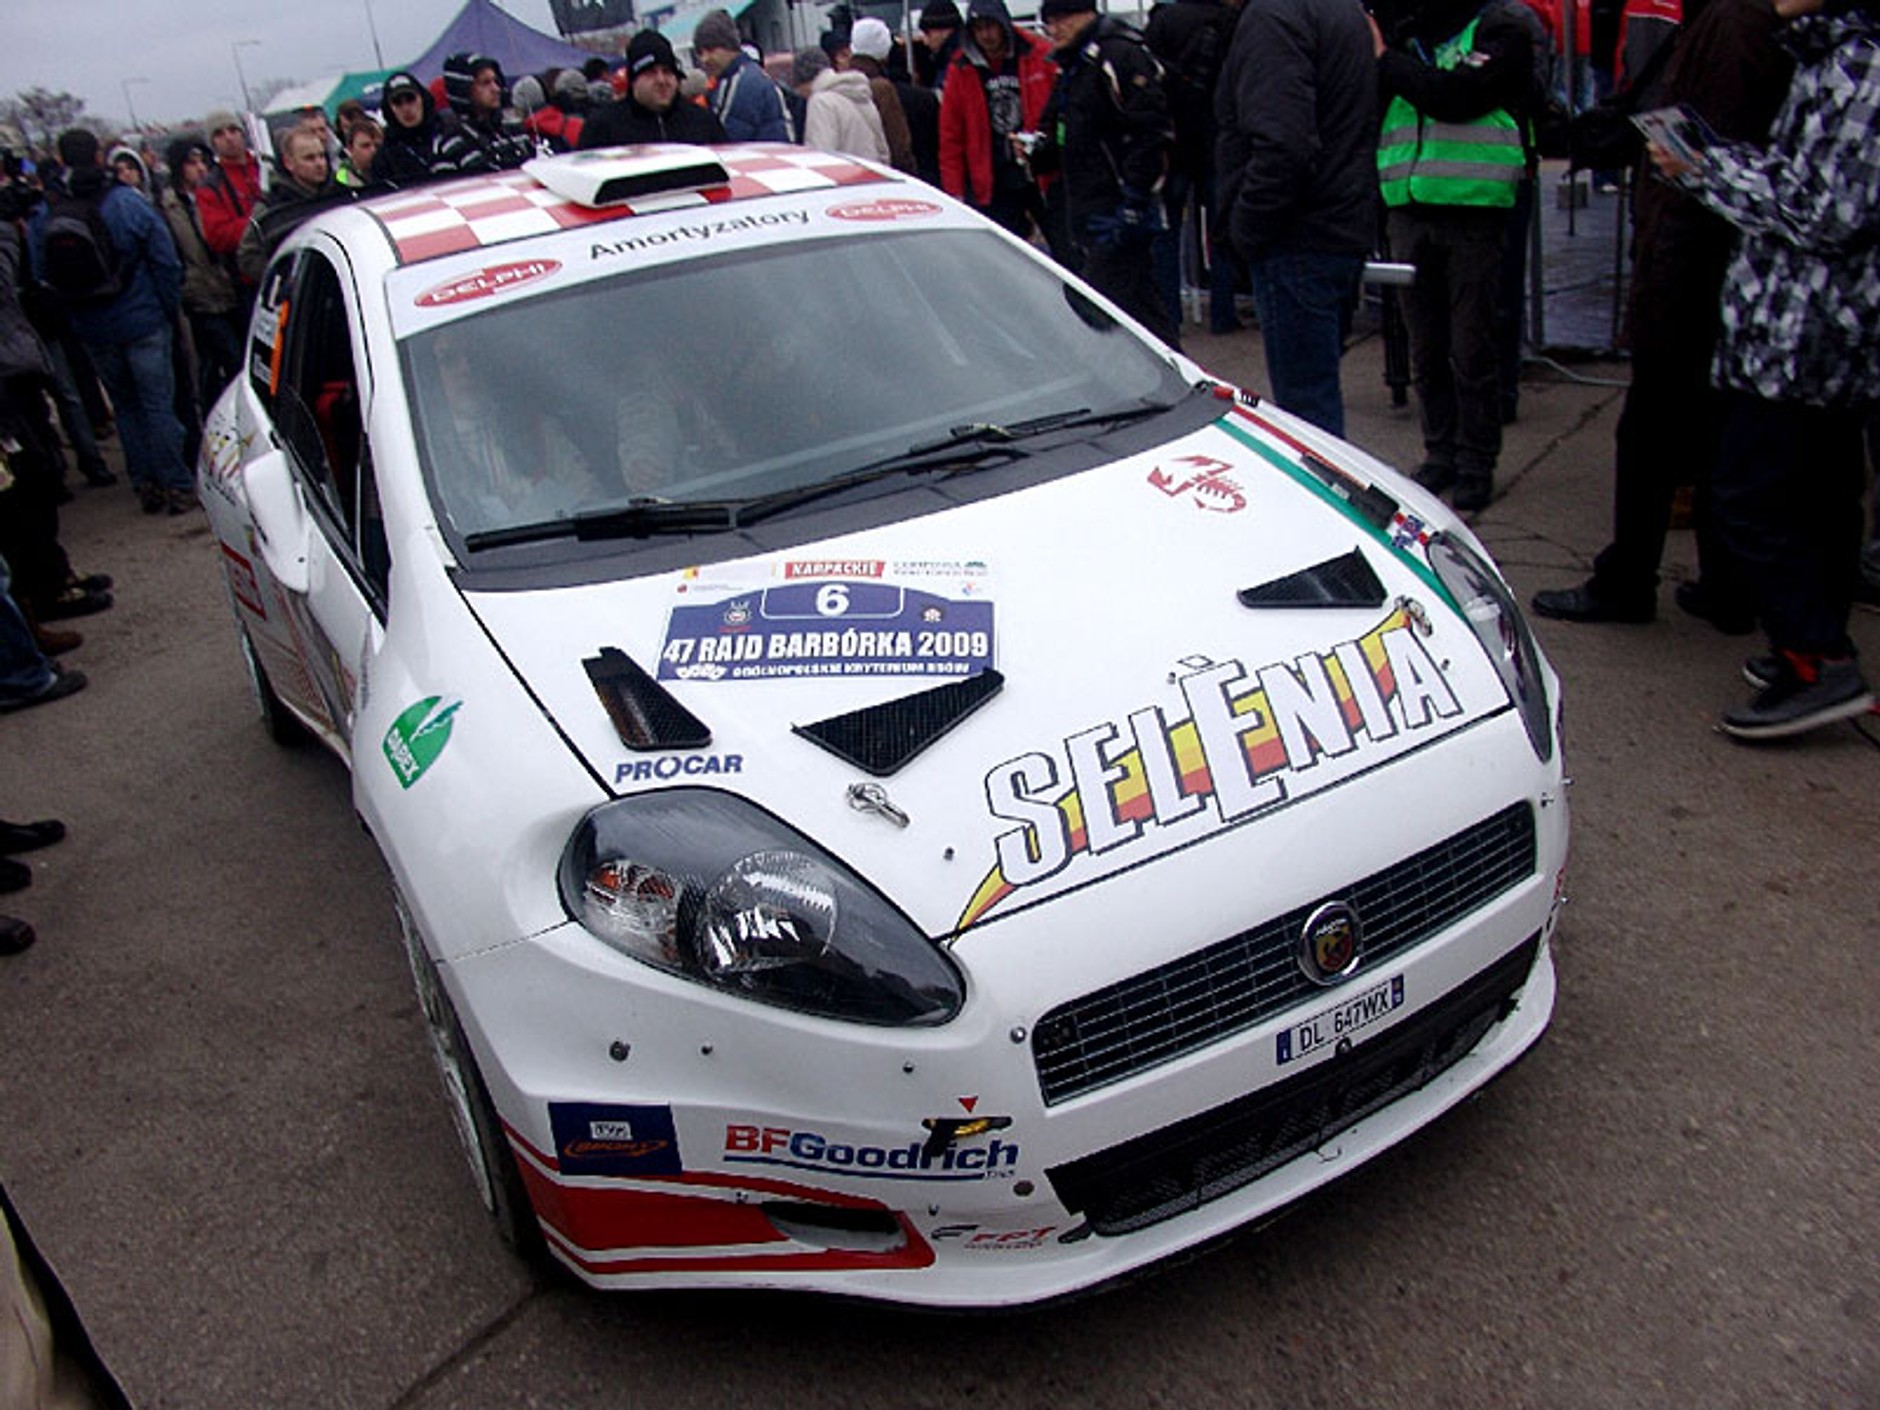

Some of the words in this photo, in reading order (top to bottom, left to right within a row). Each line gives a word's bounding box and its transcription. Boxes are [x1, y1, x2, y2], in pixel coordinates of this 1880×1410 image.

[840, 203, 932, 218] DELPHI
[591, 208, 810, 260] Amortyzatory
[431, 263, 546, 302] DELPHI
[792, 561, 878, 577] KARPACKIE
[815, 583, 850, 617] 6
[663, 638, 697, 664] 47
[698, 633, 763, 662] RAJD
[767, 627, 913, 659] BARBÓRKA
[917, 631, 988, 657] 2009
[614, 754, 744, 785] PROCAR
[1299, 1021, 1325, 1052] DL
[1334, 987, 1390, 1034] 647WX
[724, 1124, 1020, 1170] BFGoodrich
